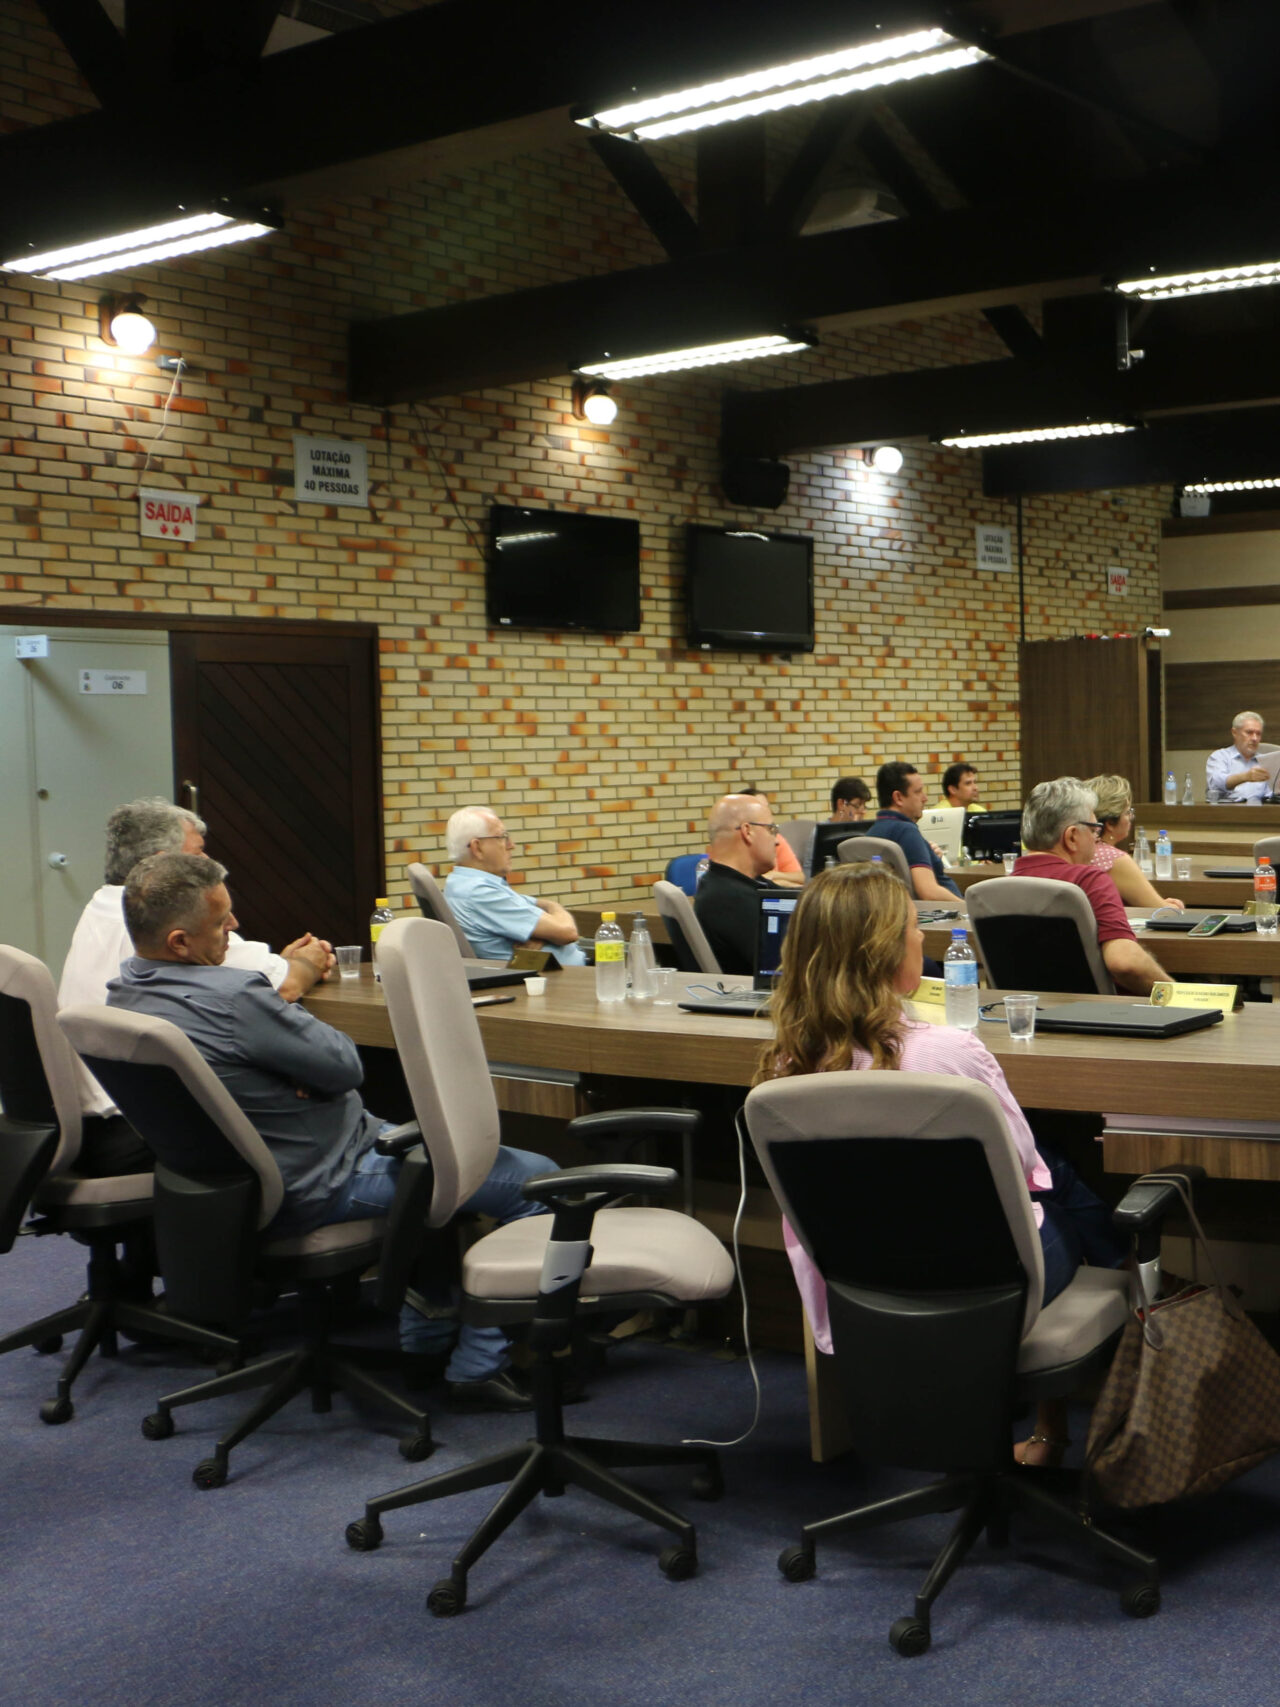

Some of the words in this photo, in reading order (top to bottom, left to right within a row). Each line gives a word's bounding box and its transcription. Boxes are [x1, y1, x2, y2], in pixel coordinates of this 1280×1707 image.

[310, 448, 351, 465] LOTAÇÃO
[304, 480, 316, 491] 40
[318, 480, 359, 496] PESSOAS
[145, 502, 193, 525] SAÍDA
[112, 681, 125, 690] 06
